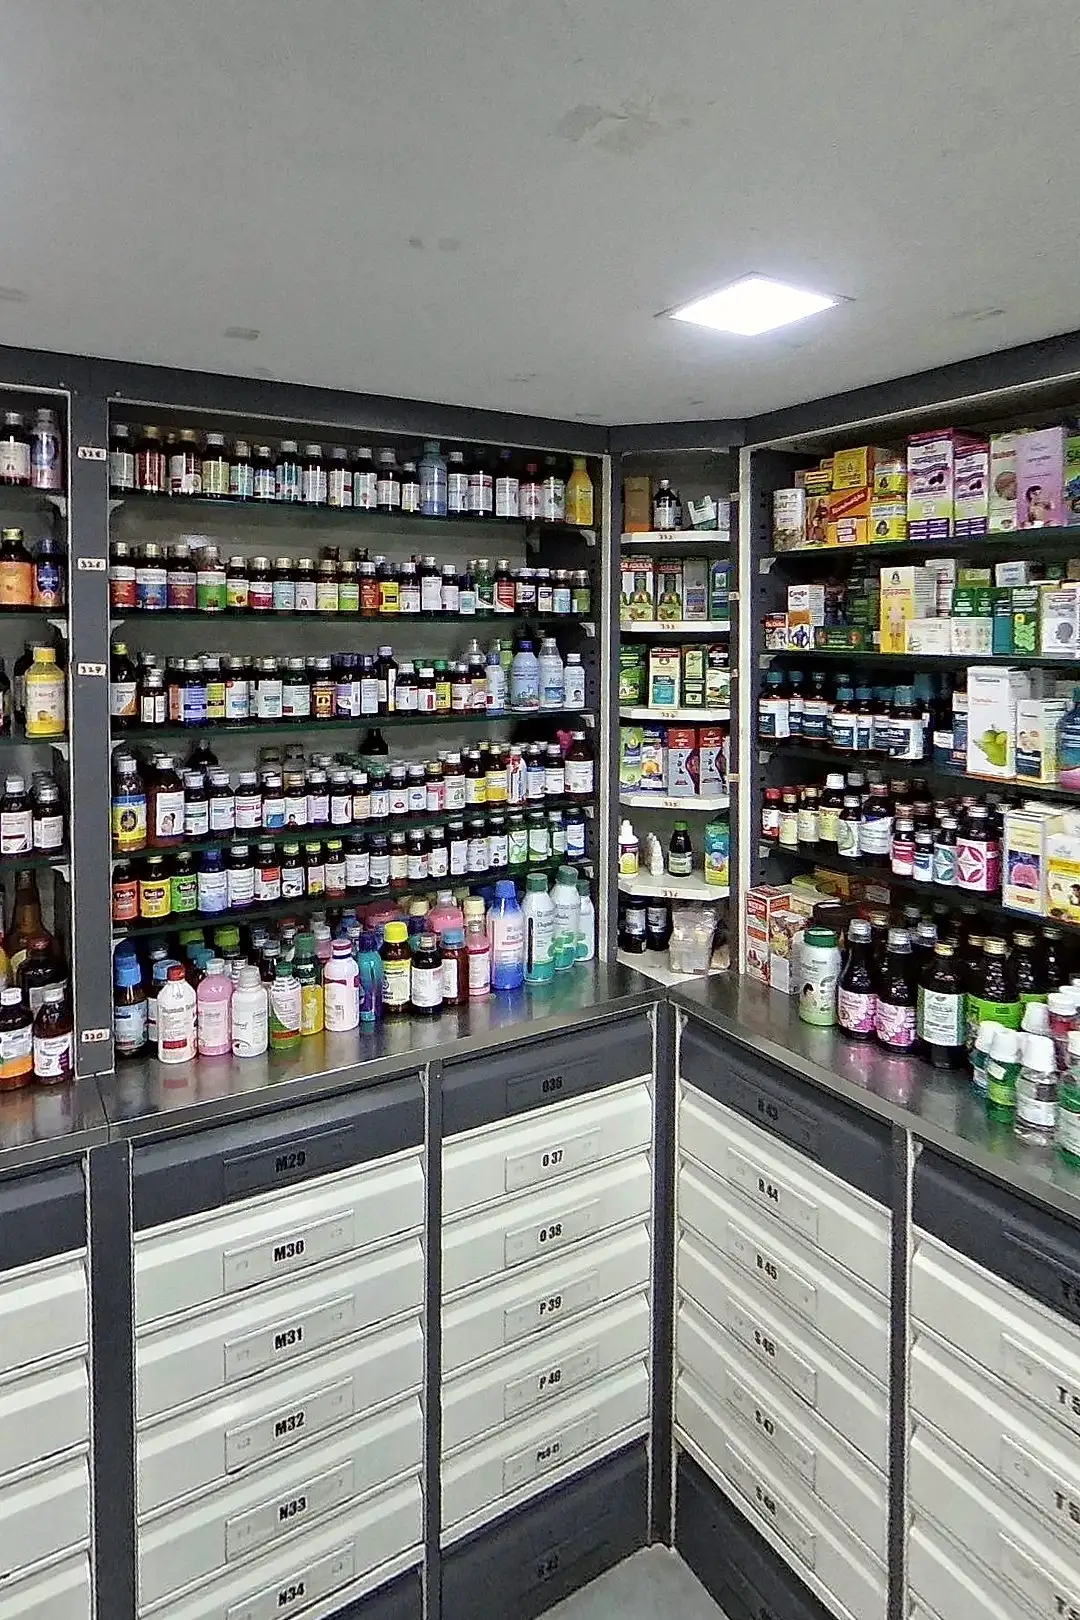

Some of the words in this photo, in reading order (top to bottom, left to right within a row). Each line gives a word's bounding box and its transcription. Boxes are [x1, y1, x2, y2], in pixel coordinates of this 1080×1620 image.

[275, 1151, 305, 1172] M29
[274, 1239, 304, 1262] M30
[275, 1327, 302, 1350] M31
[275, 1411, 304, 1438] M32
[278, 1497, 306, 1521] N33
[278, 1582, 304, 1607] N34
